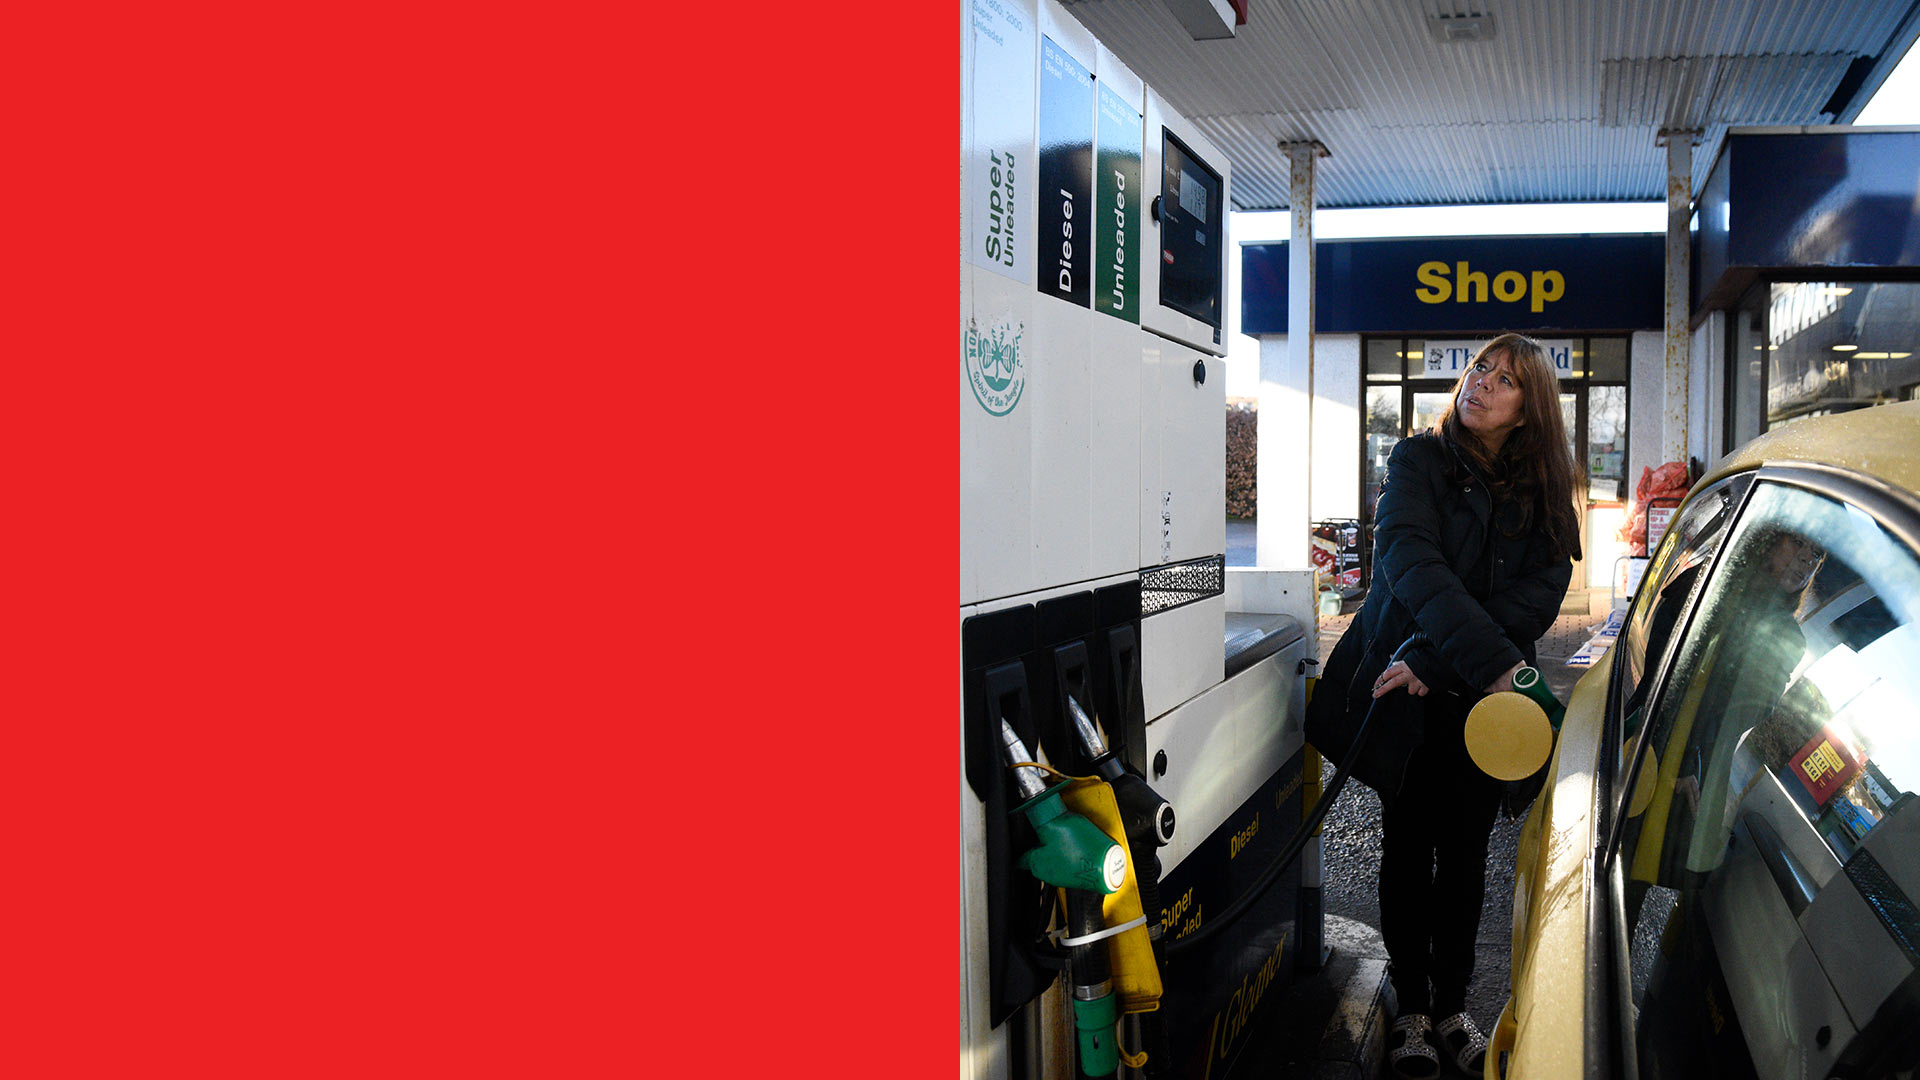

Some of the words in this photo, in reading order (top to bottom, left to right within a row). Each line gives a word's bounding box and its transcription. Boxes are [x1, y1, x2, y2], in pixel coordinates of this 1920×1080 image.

[986, 149, 1003, 262] Super
[1003, 152, 1015, 267] Unleaded
[1059, 189, 1074, 293] Diesel
[1113, 170, 1126, 311] Unleaded
[1415, 260, 1566, 312] Shop
[1446, 348, 1475, 370] Th
[1230, 812, 1260, 860] Diesel
[1161, 886, 1194, 934] Super
